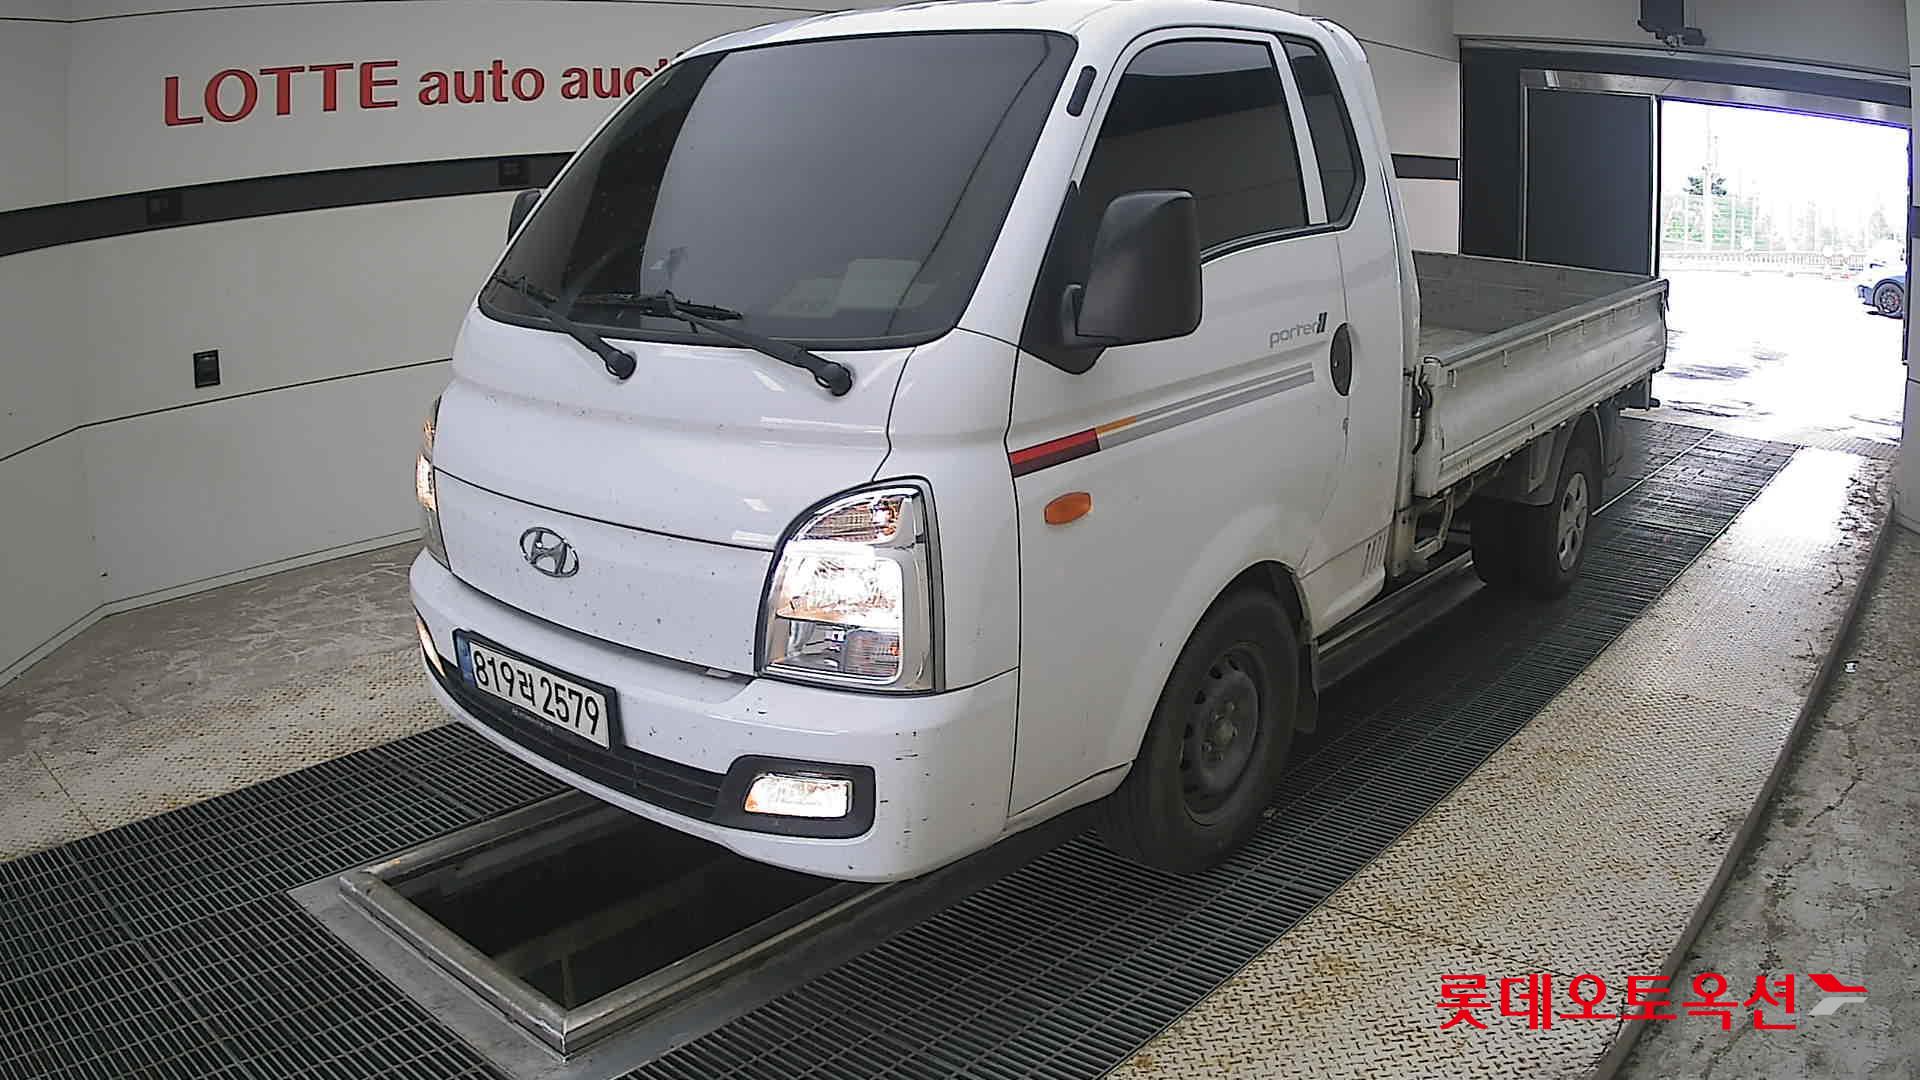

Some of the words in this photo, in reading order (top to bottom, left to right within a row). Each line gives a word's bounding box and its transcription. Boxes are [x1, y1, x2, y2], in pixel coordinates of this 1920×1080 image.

[165, 60, 398, 126] LOTTE
[419, 59, 545, 105] auto
[561, 51, 684, 99] auc
[540, 676, 600, 736] 2579
